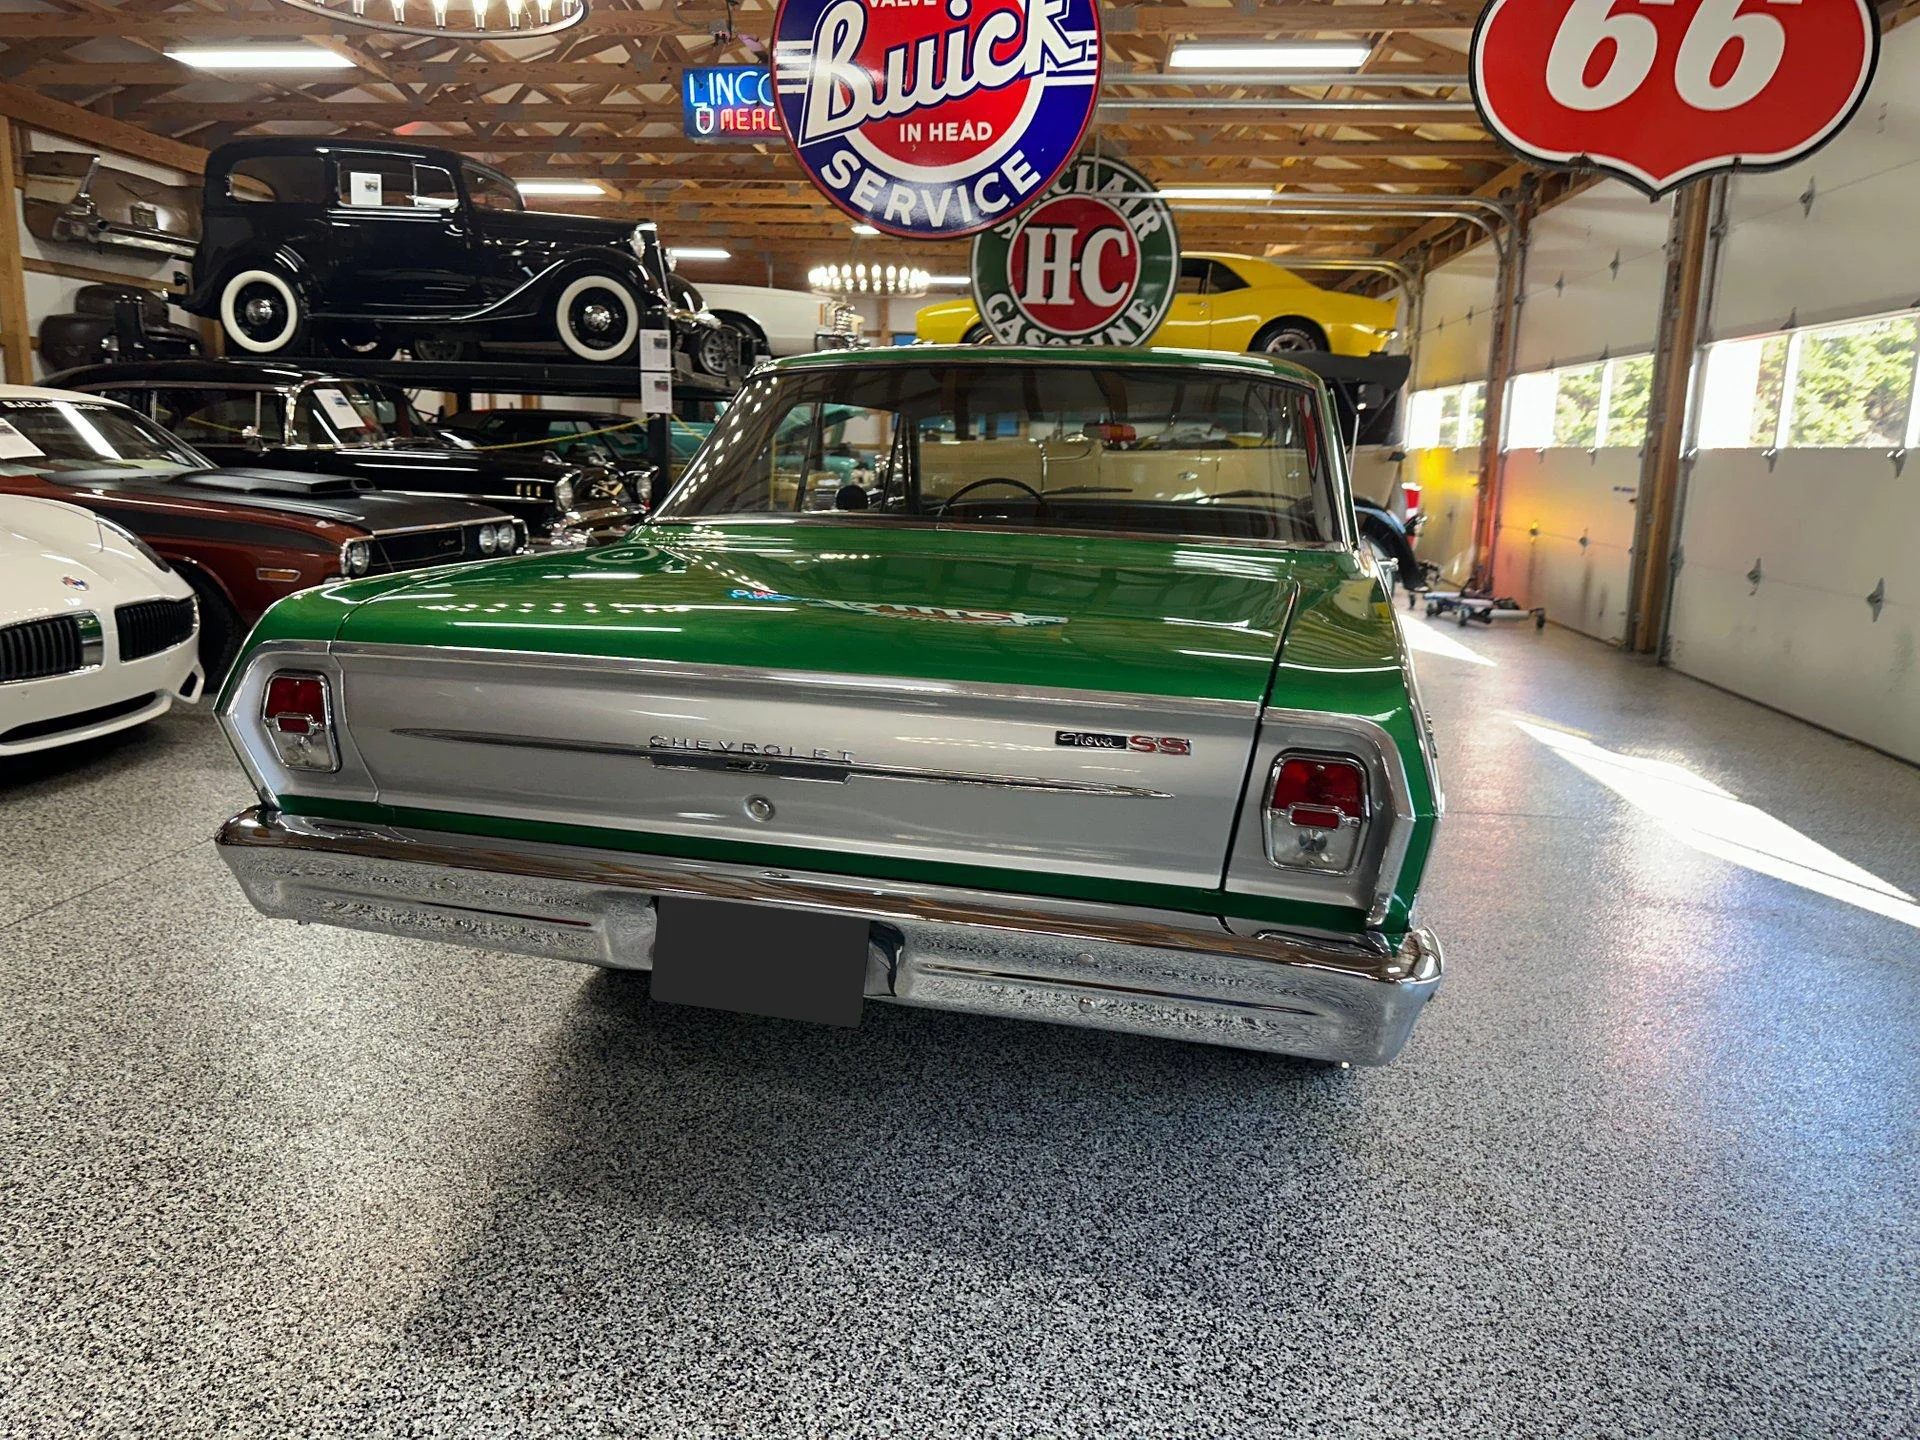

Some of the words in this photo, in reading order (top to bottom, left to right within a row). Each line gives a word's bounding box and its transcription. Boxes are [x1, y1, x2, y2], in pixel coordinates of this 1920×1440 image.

[800, 0, 1087, 146] Buick
[1545, 0, 1803, 112] 66
[900, 123, 922, 143] IN
[929, 119, 993, 142] HEAD
[820, 150, 1042, 228] SERVICE
[650, 735, 855, 761] CHEVROLET
[1060, 733, 1124, 748] Nova
[1127, 735, 1190, 755] SS
